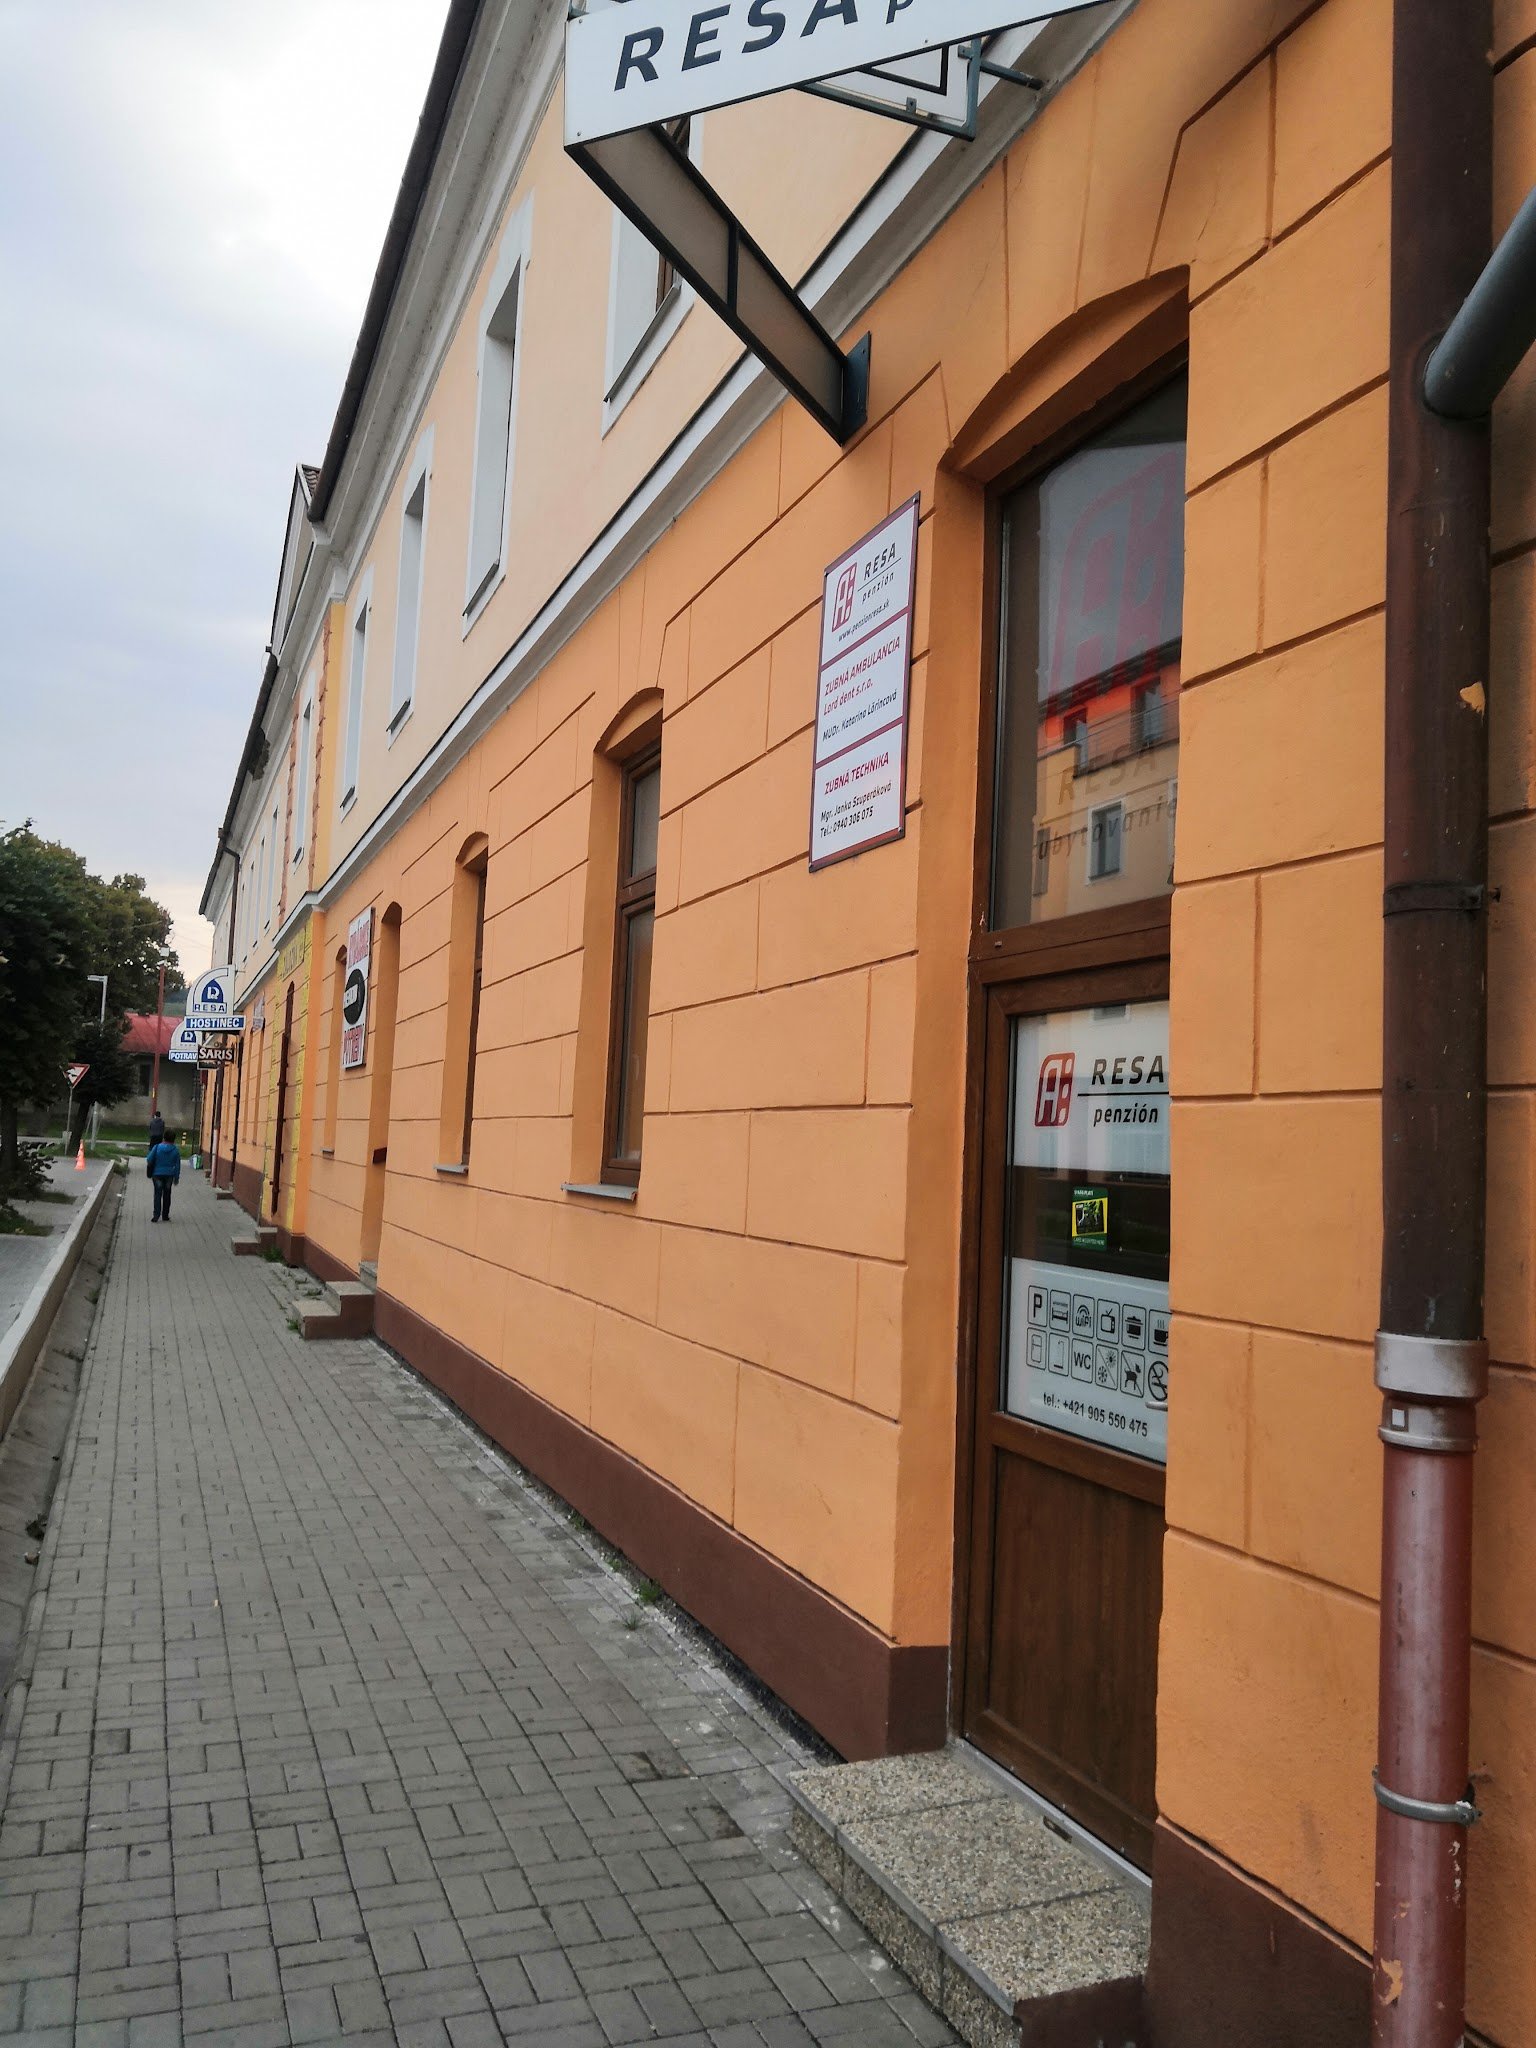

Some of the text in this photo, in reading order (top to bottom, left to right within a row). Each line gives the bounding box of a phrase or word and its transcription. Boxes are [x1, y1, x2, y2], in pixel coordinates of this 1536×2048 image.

[614, 0, 858, 91] RESA
[864, 543, 896, 580] RESA
[862, 572, 894, 604] penzión
[825, 636, 900, 696] ZUBNÁ AMBULANCIA
[824, 678, 873, 716] Lord dent s.r.o.
[822, 725, 840, 742] MUDr.
[825, 752, 889, 795] ZUBNÁ TECHNIKA
[821, 810, 833, 823] Mgr.
[833, 816, 848, 833] 0940
[849, 810, 861, 826] 306
[862, 805, 874, 820] 075
[194, 1003, 225, 1012] RESA
[190, 1018, 240, 1028] HOSTINEC
[1091, 1055, 1164, 1085] RESA
[1093, 1102, 1158, 1127] penzión
[1073, 1351, 1091, 1369] WC
[1043, 1391, 1148, 1437] tel.: +421 905 550 475
